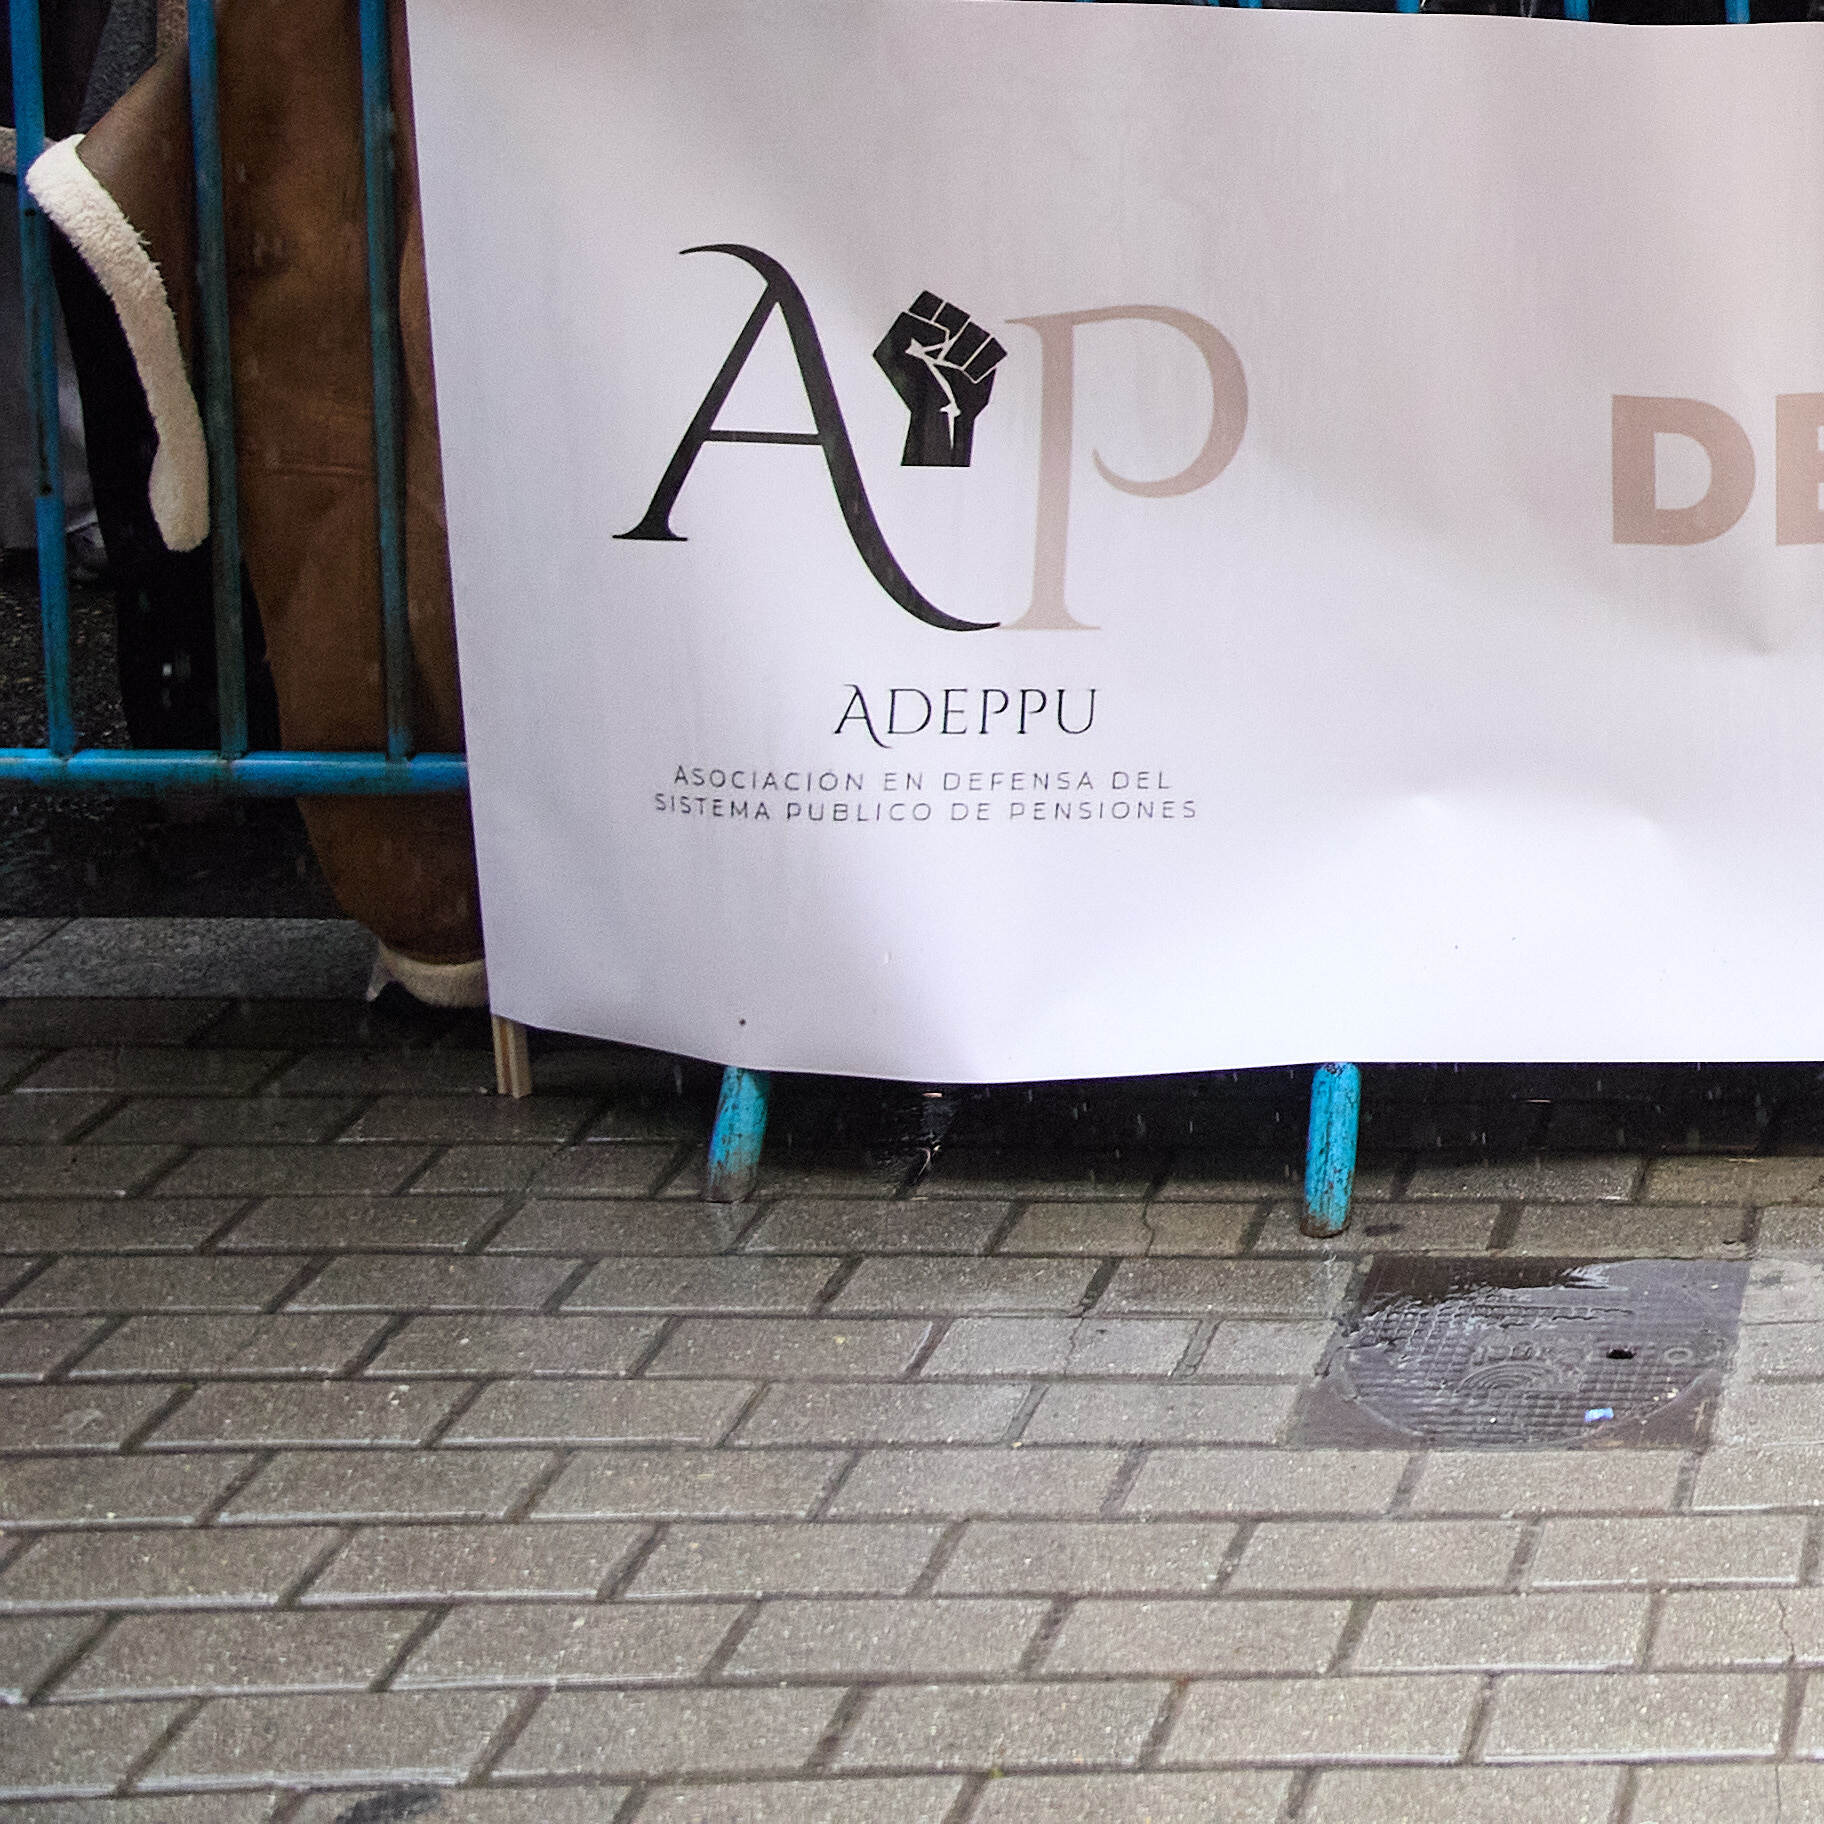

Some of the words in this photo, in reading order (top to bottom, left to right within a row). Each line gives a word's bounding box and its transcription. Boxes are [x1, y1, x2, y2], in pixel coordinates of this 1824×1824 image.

[832, 683, 1098, 750] ADEPPU
[884, 771, 923, 792] EN
[943, 771, 1094, 792] DEFENSA
[1111, 770, 1171, 791] DEL
[653, 792, 771, 822] SISTEMA
[951, 801, 991, 822] DE
[1009, 799, 1197, 822] PENSIONES
